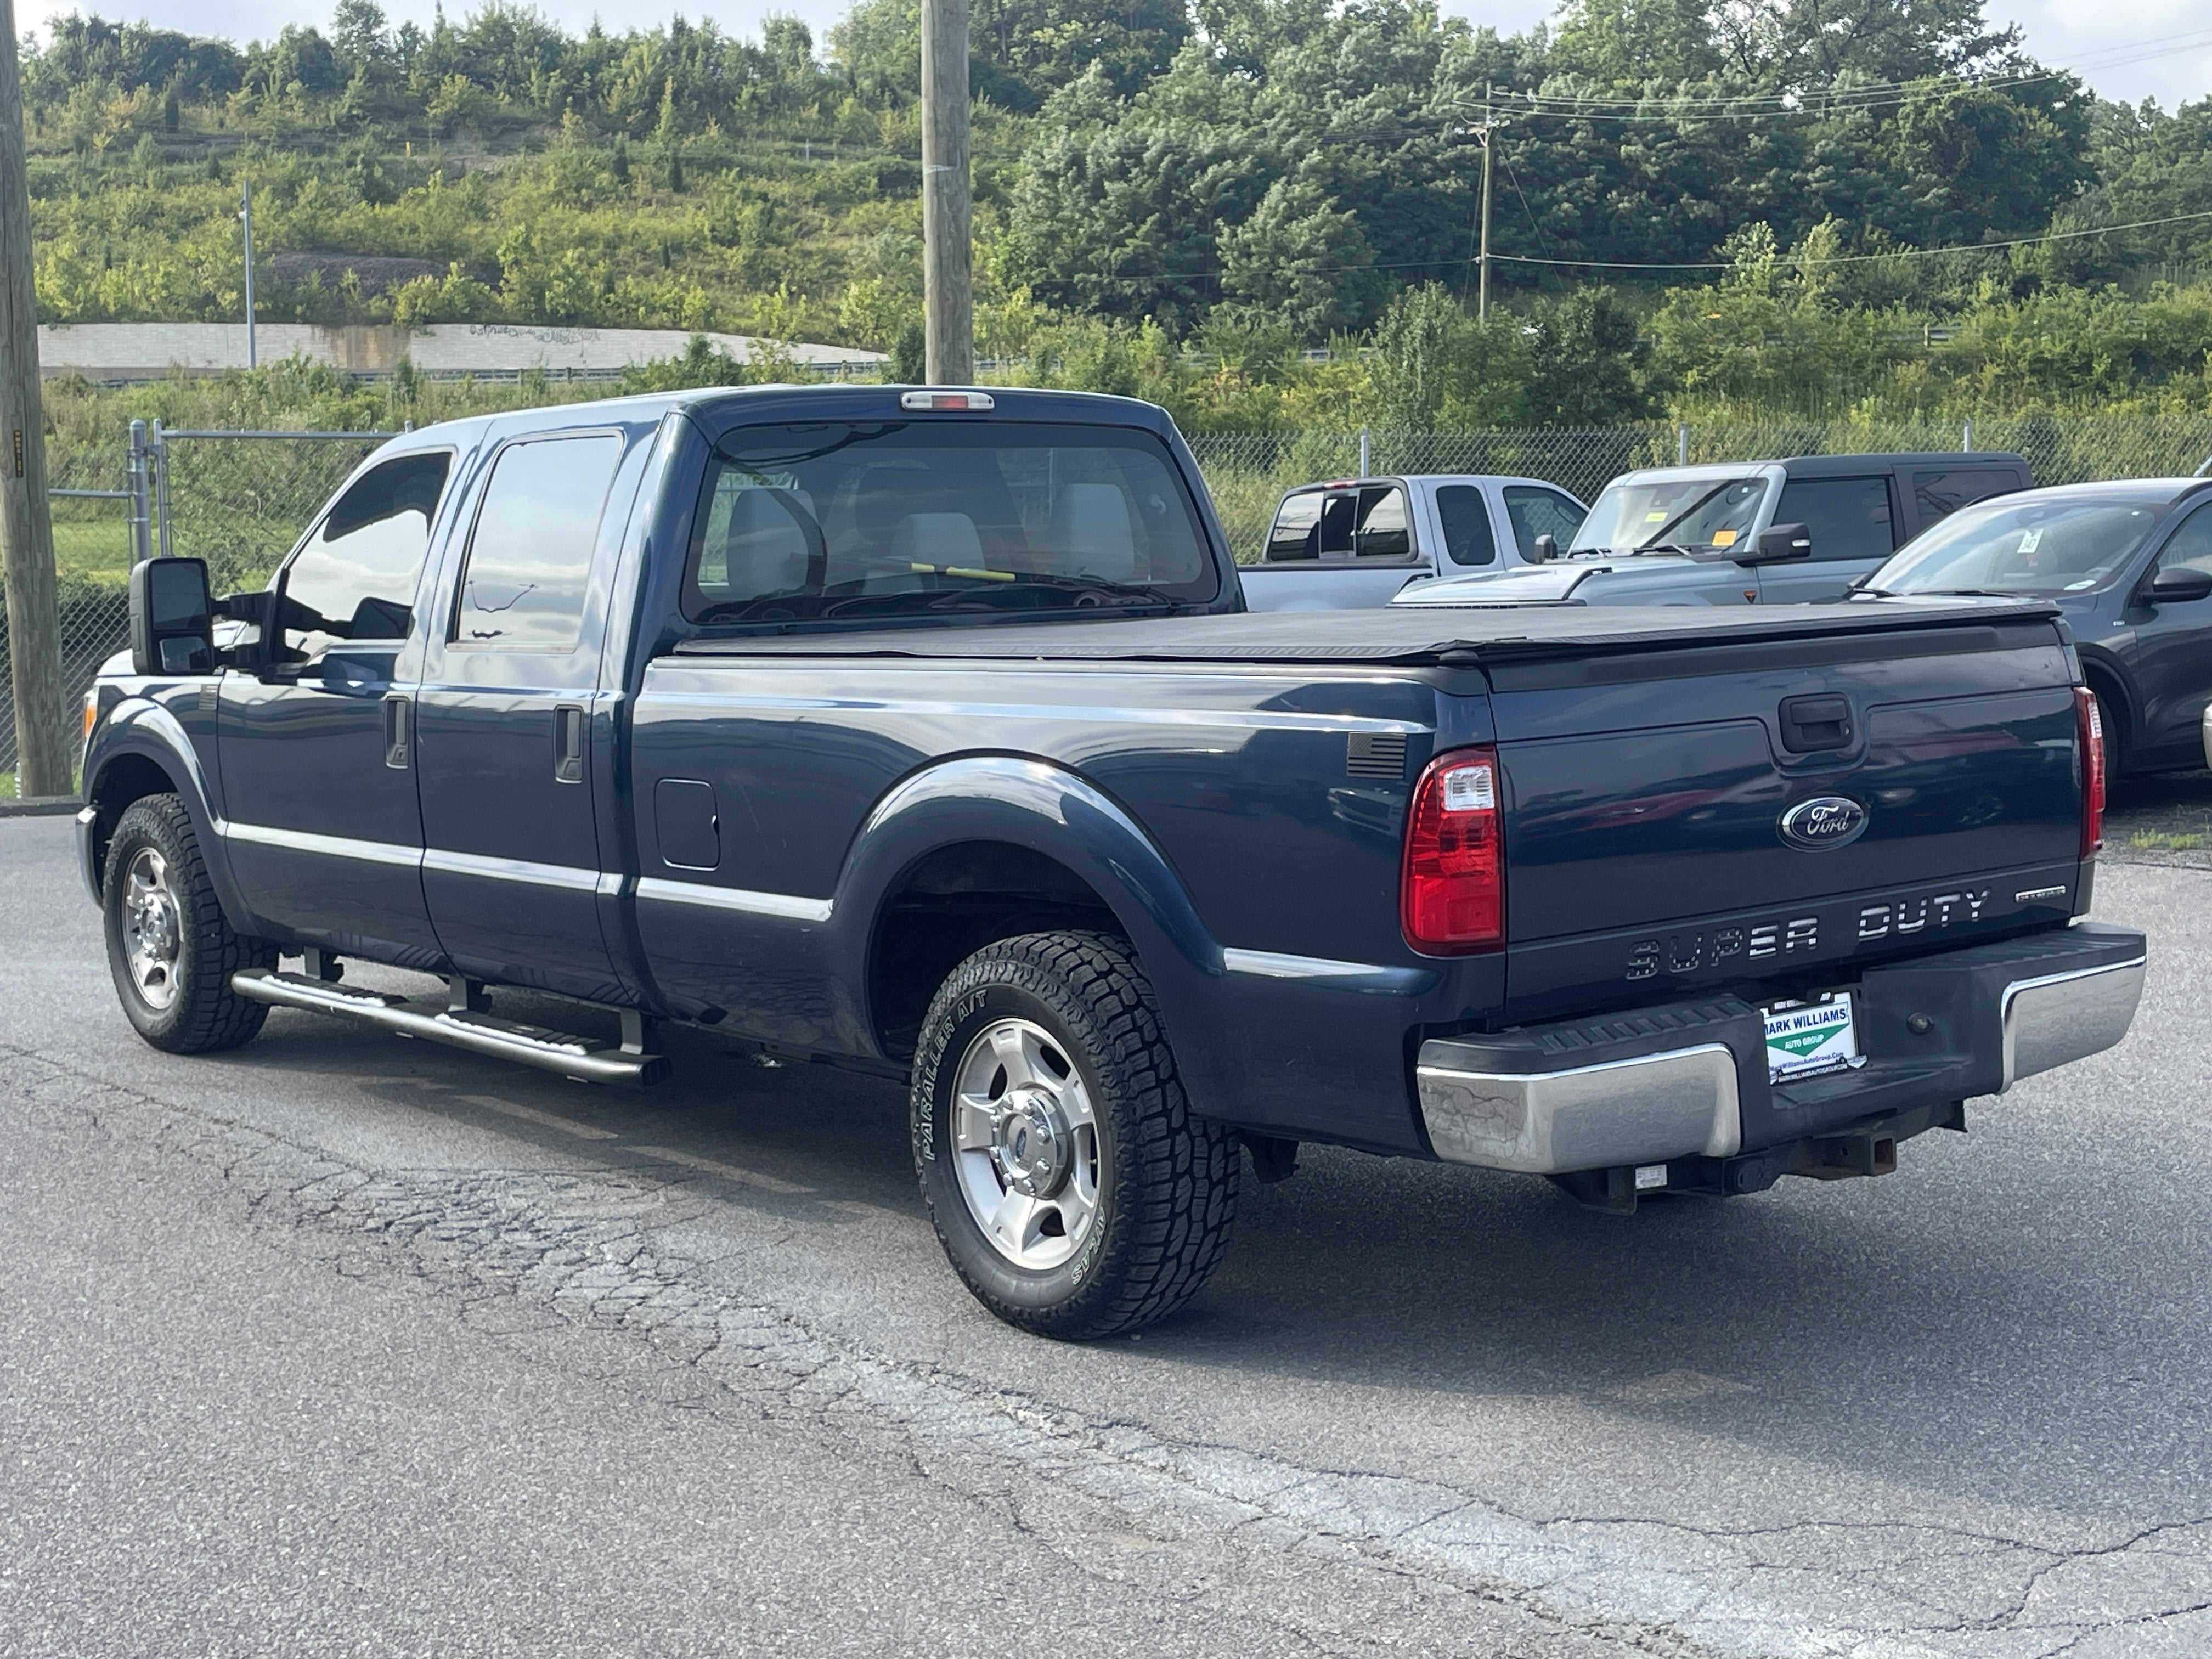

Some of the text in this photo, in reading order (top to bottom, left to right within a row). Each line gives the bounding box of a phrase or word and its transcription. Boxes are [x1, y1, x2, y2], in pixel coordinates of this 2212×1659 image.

[1807, 806, 1850, 835] Ford
[1625, 885, 1991, 980] SUPER DUTY
[1793, 1008, 1846, 1029] WILLIAMS
[1785, 1034, 1825, 1049] AUTO GROUP
[921, 989, 987, 1160] PARALLER A/T
